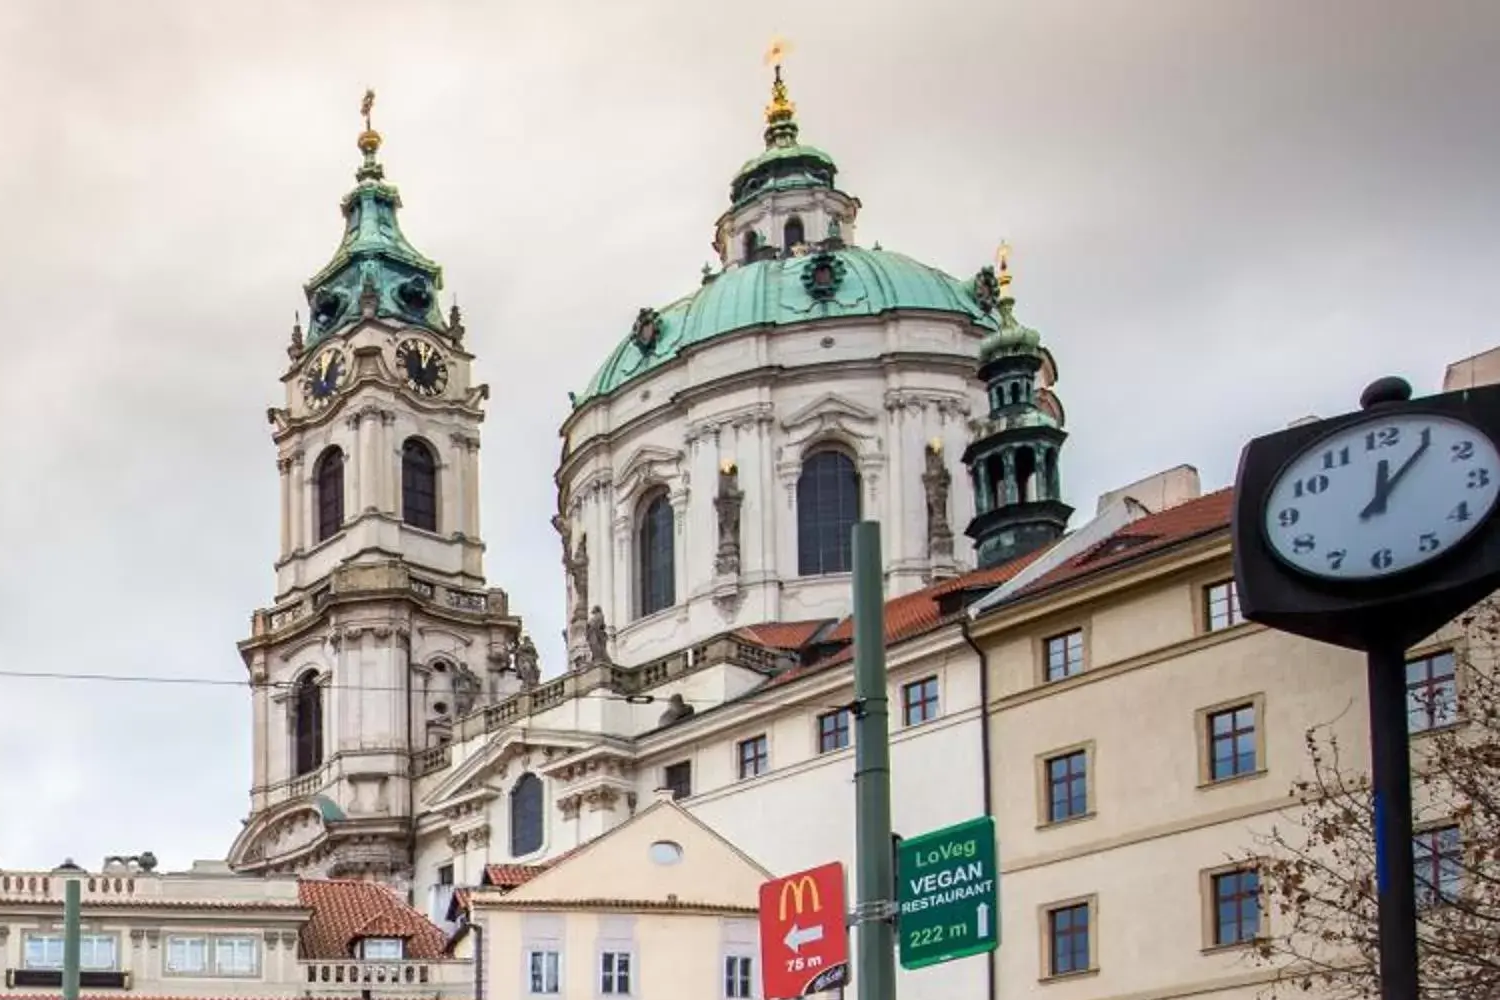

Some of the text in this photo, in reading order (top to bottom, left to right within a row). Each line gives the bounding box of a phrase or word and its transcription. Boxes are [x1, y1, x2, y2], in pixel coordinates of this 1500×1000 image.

[1364, 427, 1399, 451] 12
[1323, 446, 1351, 470] 11
[1451, 441, 1474, 461] 2
[1293, 474, 1329, 498] 10
[1466, 468, 1490, 489] 3
[1278, 508, 1299, 527] 9
[1447, 501, 1472, 522] 4
[1293, 533, 1315, 554] 8
[1419, 532, 1440, 552] 5
[1327, 549, 1347, 570] 7
[1370, 549, 1393, 570] 6
[915, 839, 976, 868] LoVeg
[910, 861, 983, 895] VEGAN
[902, 880, 993, 914] RESTAURANT
[910, 923, 967, 948] 222 m
[786, 955, 822, 972] 75 m
